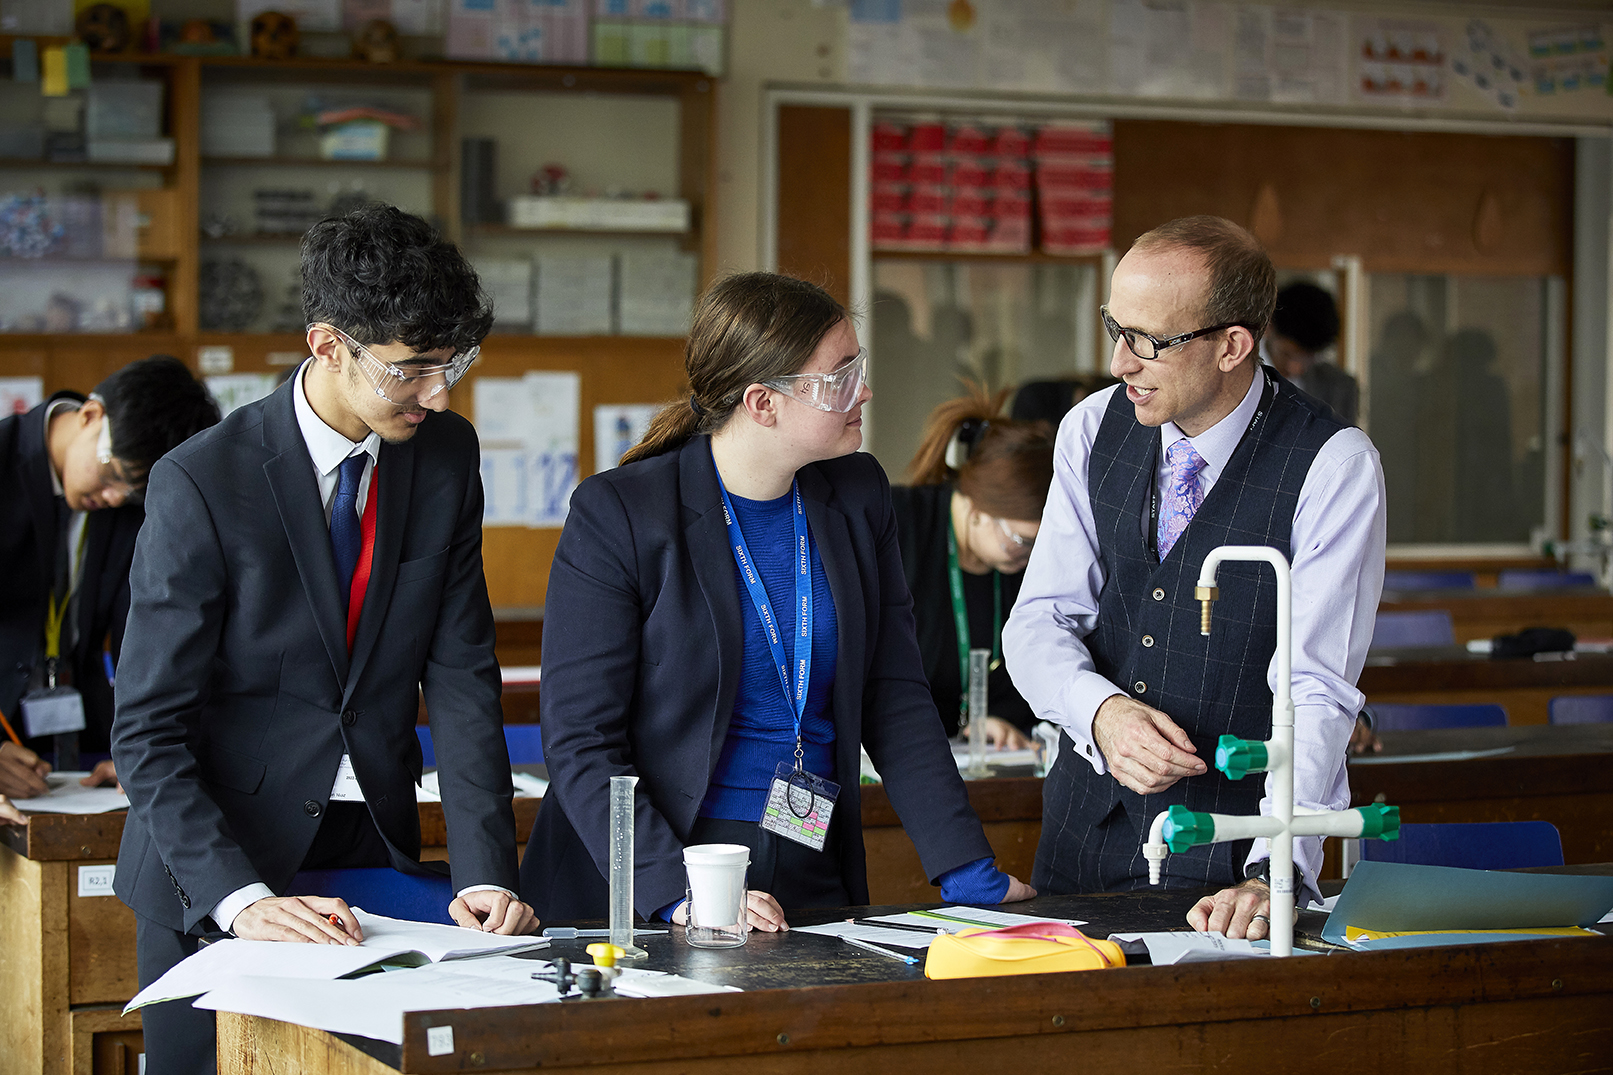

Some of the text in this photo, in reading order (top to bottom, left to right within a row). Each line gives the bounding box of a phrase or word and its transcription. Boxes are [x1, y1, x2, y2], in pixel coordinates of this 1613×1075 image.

[735, 545, 756, 584] SIXTH FORM
[760, 604, 778, 644] SIXTH FORM
[796, 659, 806, 701] SIXTH FORM
